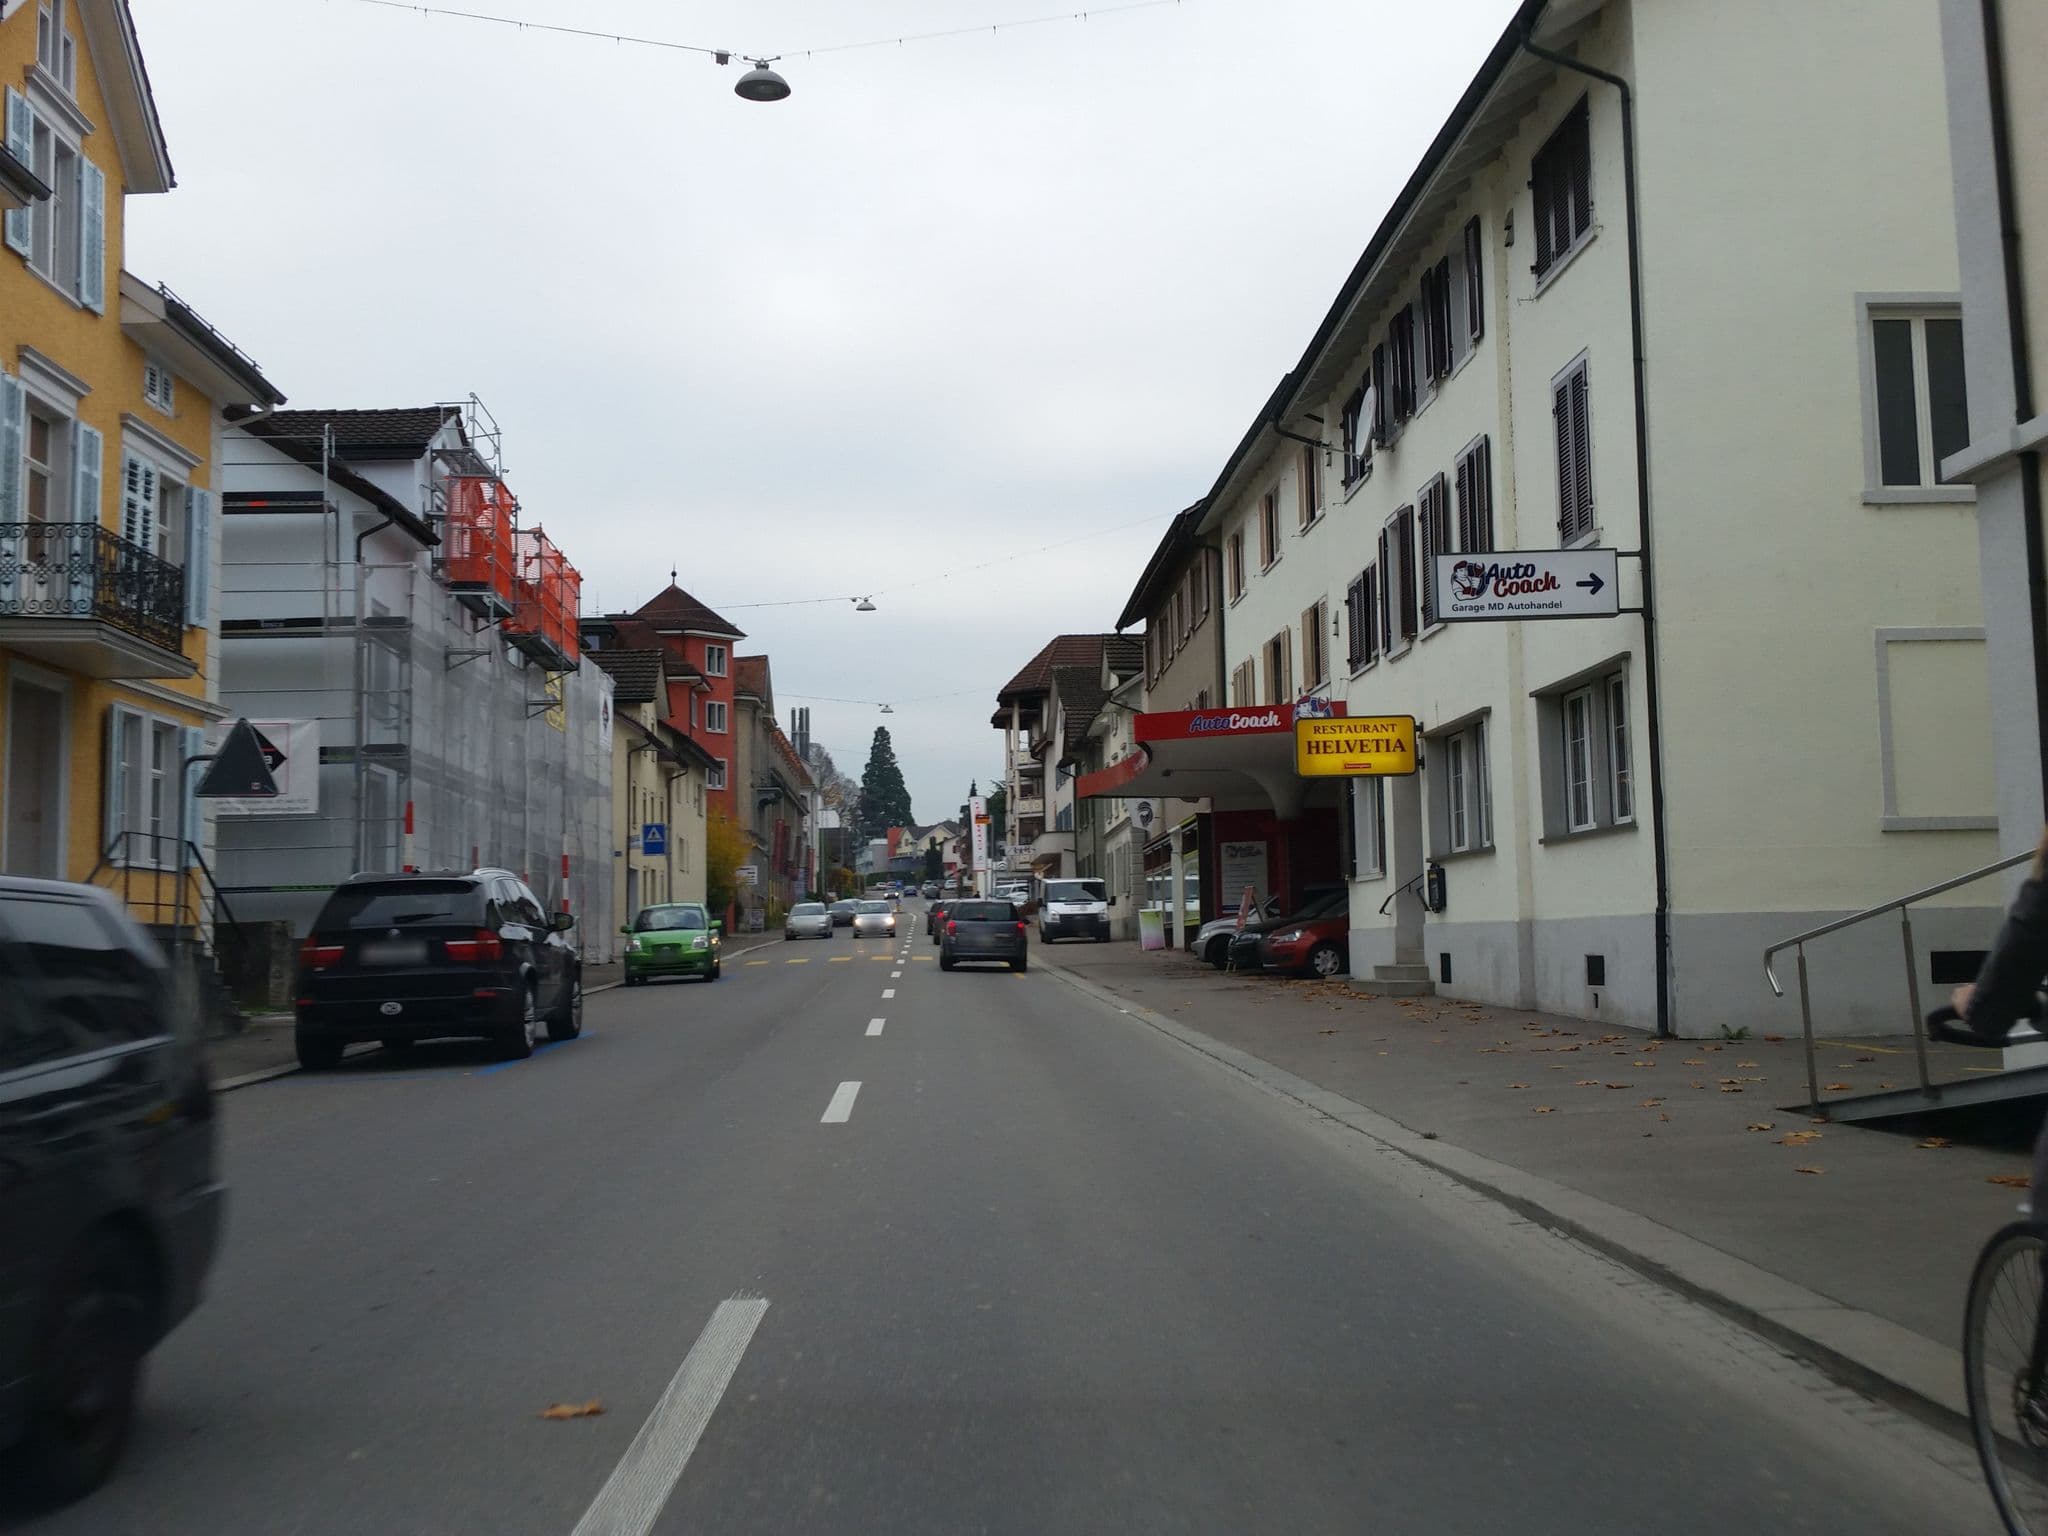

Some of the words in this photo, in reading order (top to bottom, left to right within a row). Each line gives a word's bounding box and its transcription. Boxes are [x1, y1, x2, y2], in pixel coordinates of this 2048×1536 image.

[1486, 562, 1536, 584] Auto
[1494, 571, 1561, 598] Coach
[1452, 603, 1486, 613] Garage
[1488, 602, 1504, 611] MD
[1507, 600, 1563, 610] Autohandel
[1313, 723, 1398, 735] RESTAURANT
[1306, 738, 1407, 755] HELVETIA
